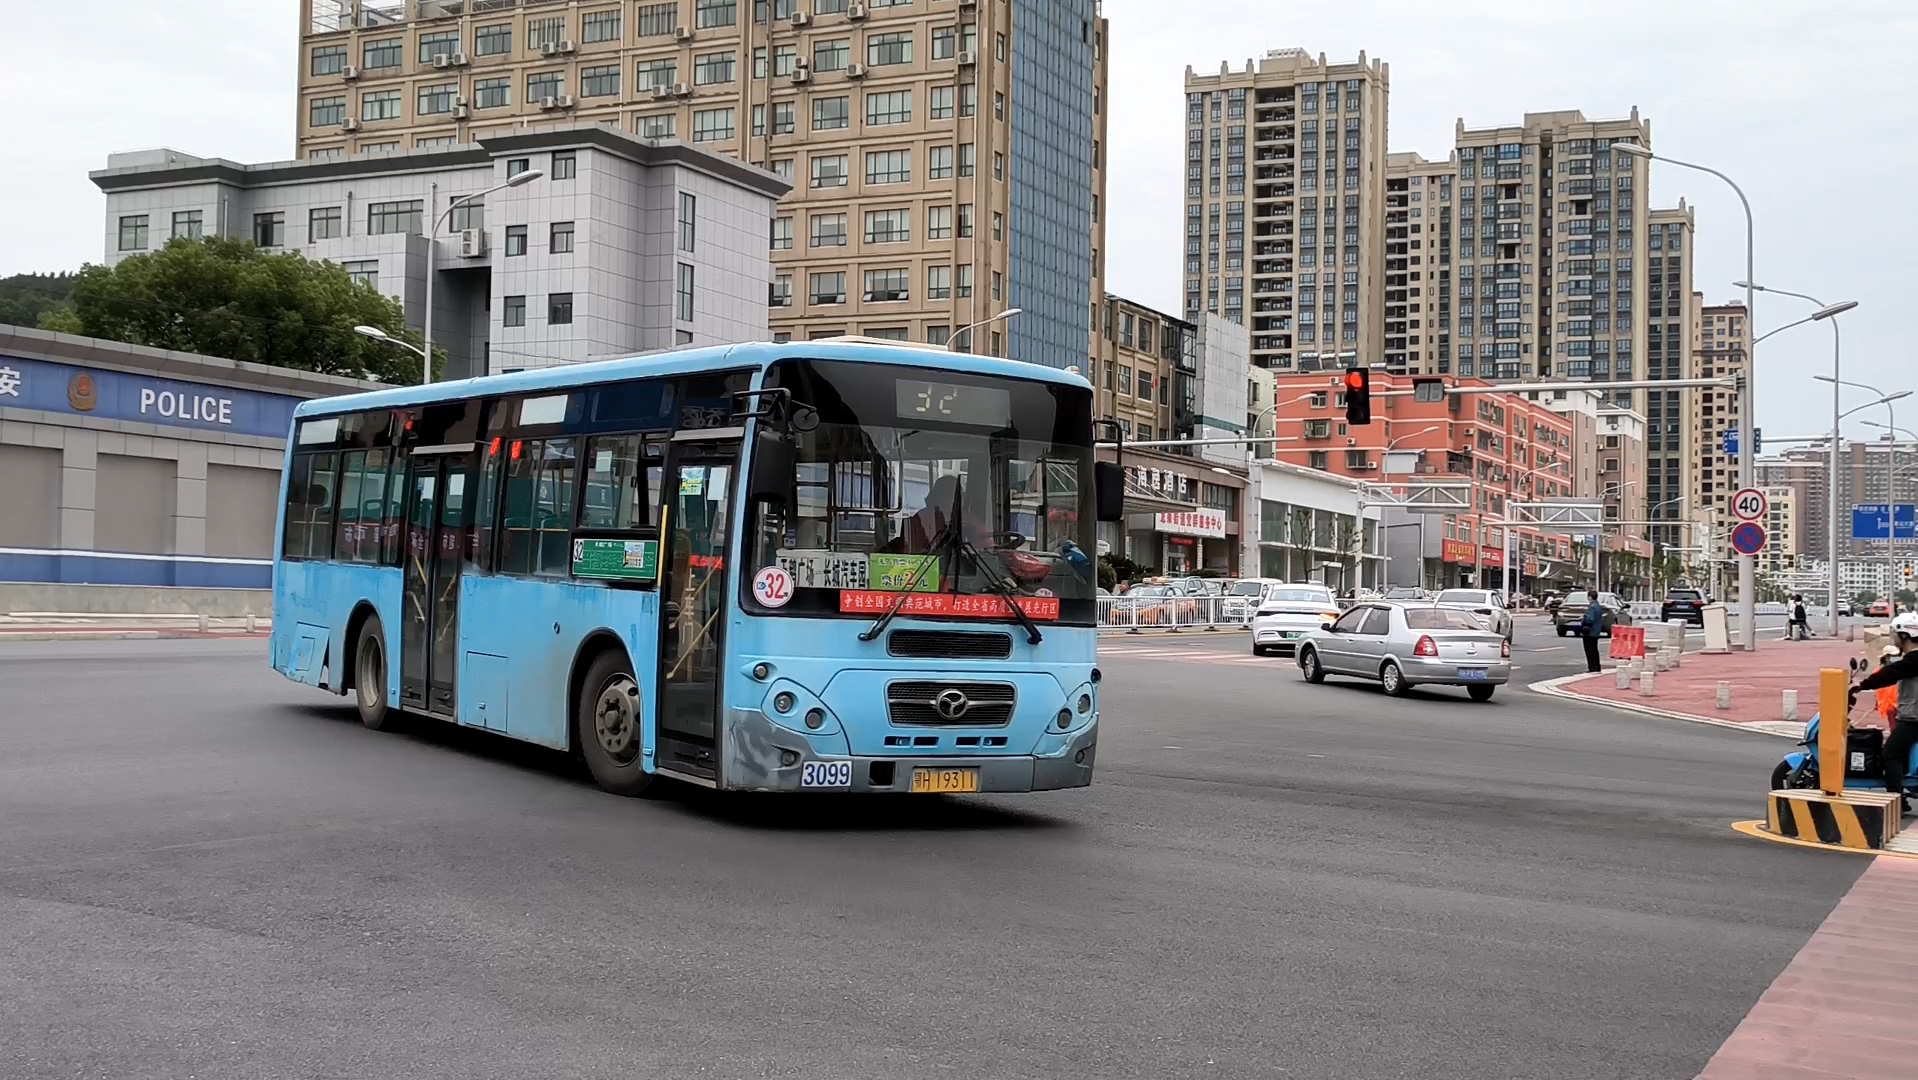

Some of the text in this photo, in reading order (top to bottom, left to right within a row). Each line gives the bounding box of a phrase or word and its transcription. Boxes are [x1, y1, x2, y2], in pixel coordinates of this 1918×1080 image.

[140, 388, 232, 424] POLICE
[1738, 496, 1760, 513] 40
[765, 573, 785, 599] 32
[803, 763, 850, 786] 3099
